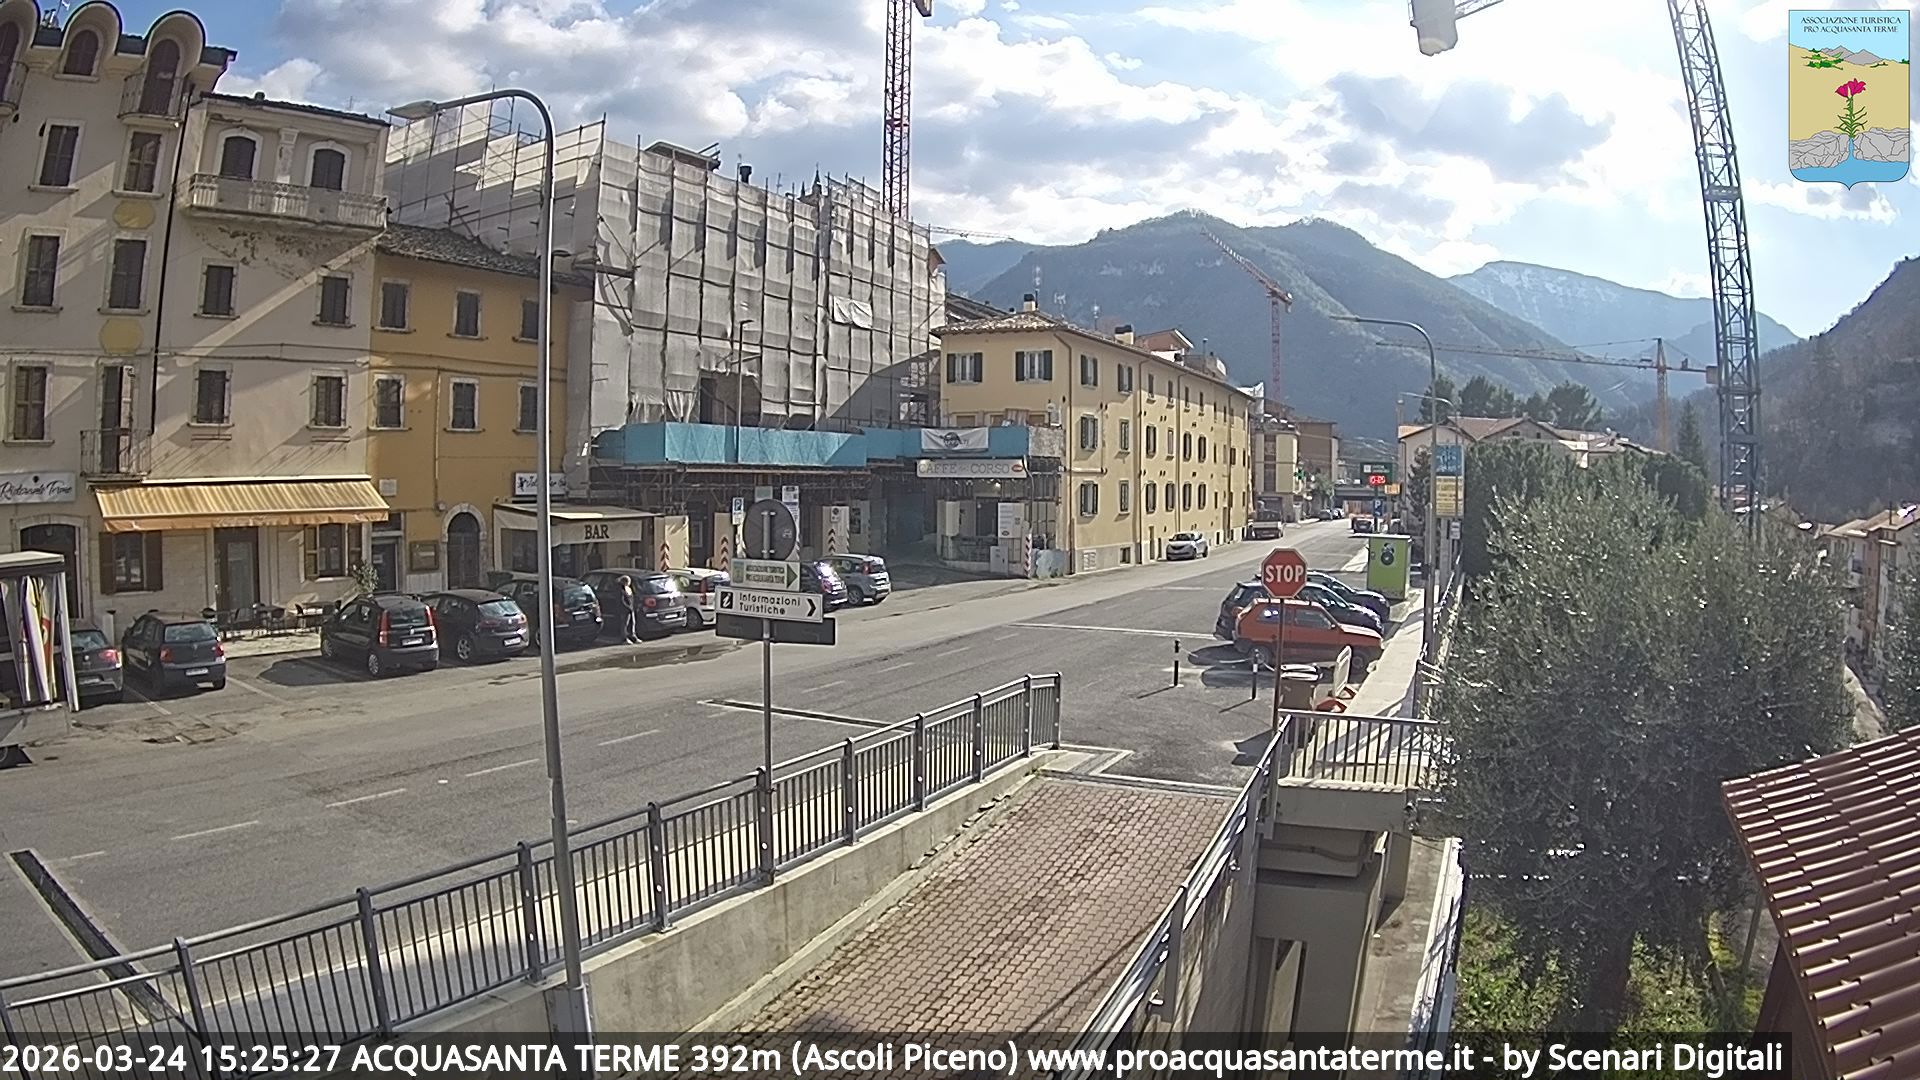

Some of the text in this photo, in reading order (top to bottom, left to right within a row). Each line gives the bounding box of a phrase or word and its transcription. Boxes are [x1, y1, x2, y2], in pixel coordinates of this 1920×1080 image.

[970, 463, 1010, 475] CORSO
[584, 524, 610, 540] BAR
[1265, 565, 1304, 583] STOP
[739, 592, 801, 607] Informazioni
[739, 602, 786, 616] Turistiche
